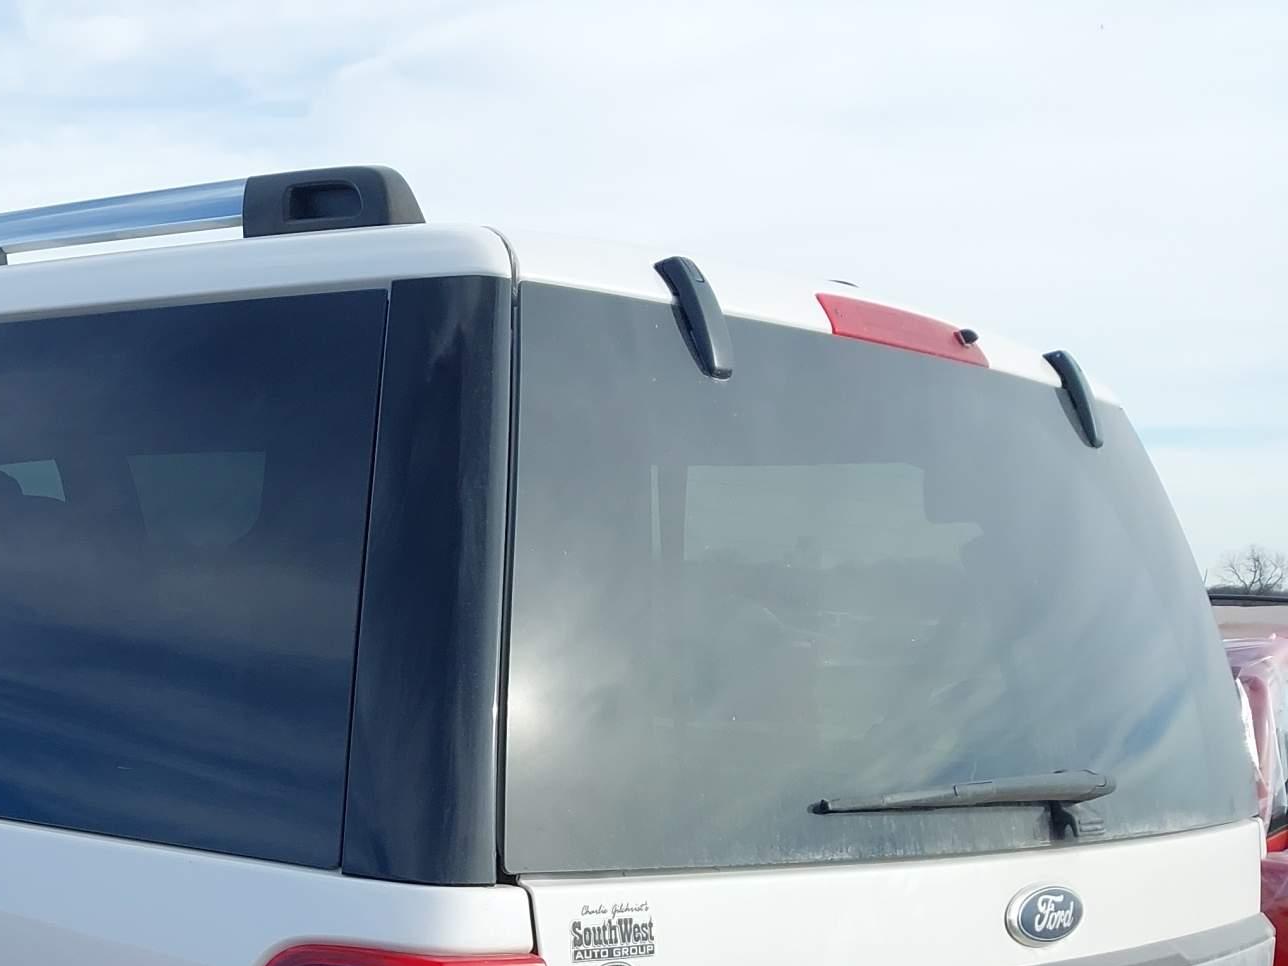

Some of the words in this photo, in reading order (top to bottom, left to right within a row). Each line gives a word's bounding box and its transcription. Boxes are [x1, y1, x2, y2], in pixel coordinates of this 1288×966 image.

[1034, 894, 1074, 932] Ford
[571, 915, 655, 947] SouthWest
[575, 948, 609, 960] AUTO
[612, 946, 654, 957] GROUP
